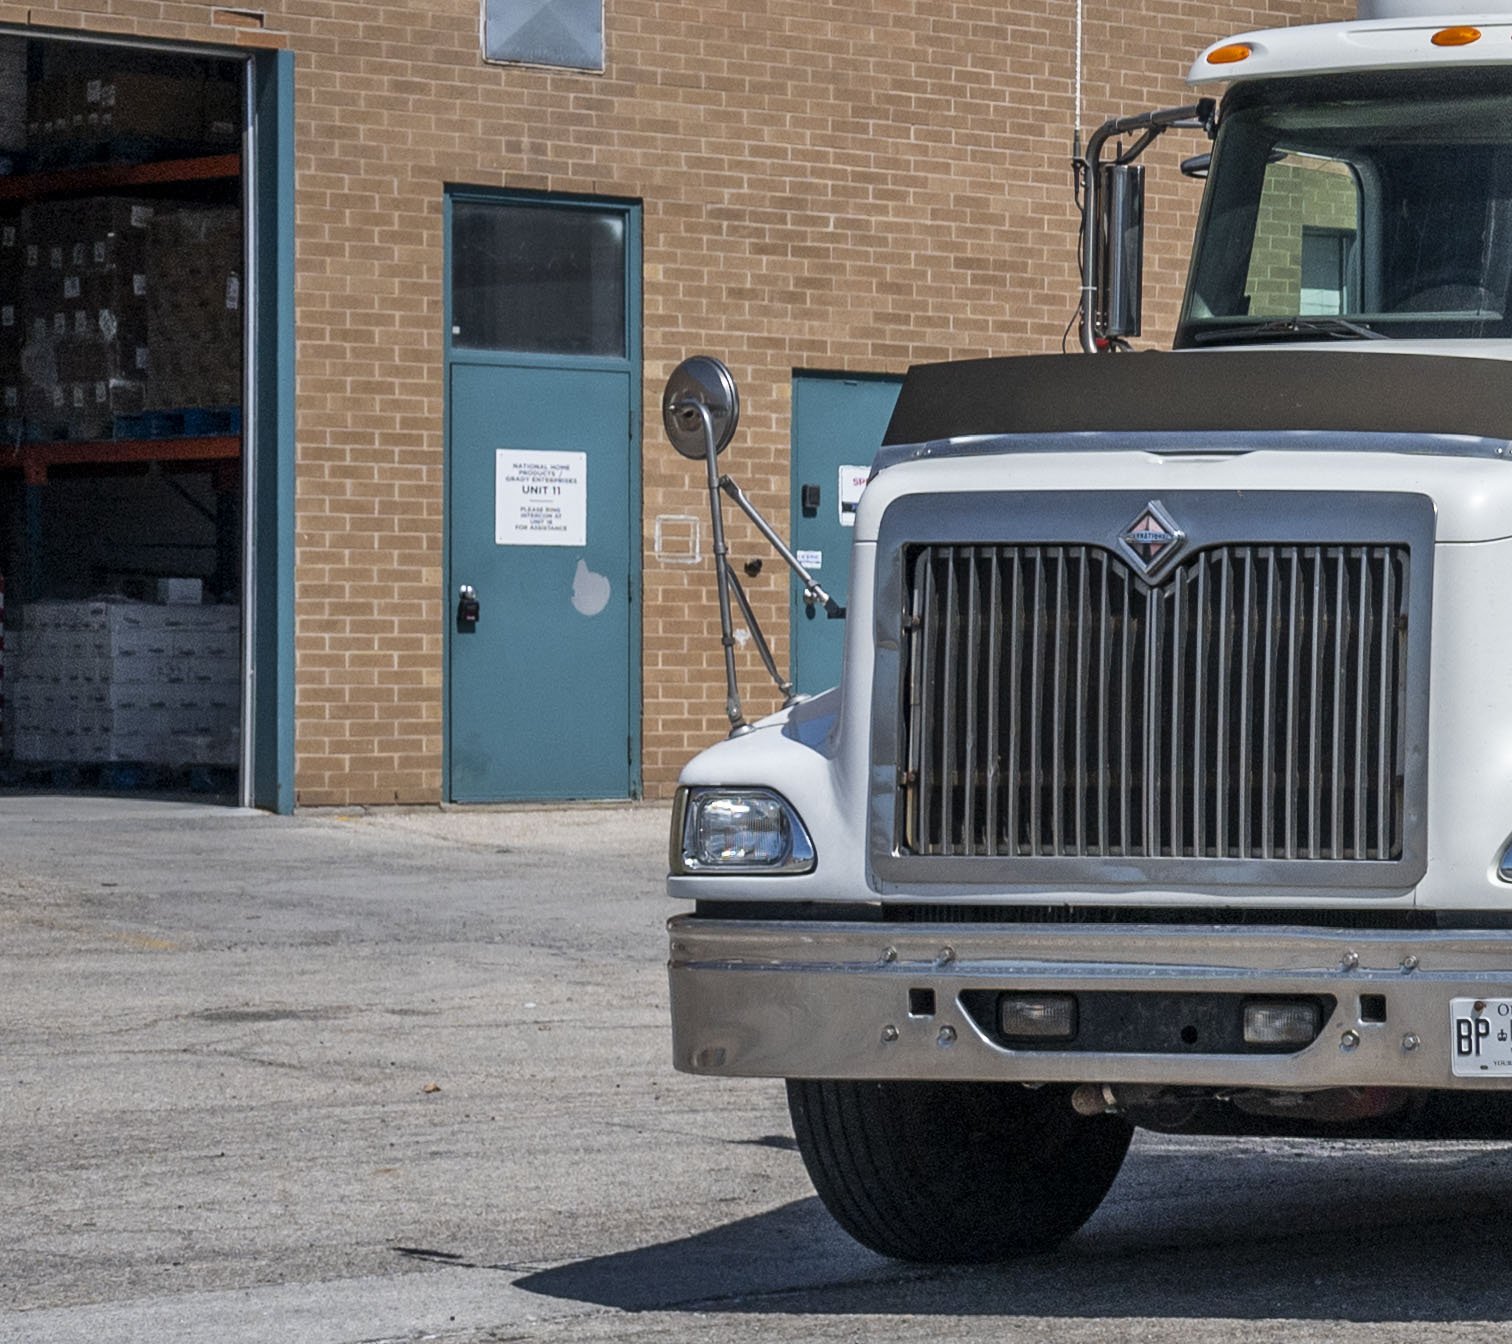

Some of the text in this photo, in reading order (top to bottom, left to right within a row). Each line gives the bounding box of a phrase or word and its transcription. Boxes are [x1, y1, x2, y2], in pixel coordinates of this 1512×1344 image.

[522, 485, 561, 495] UNIT 11
[1456, 1018, 1490, 1056] BP
